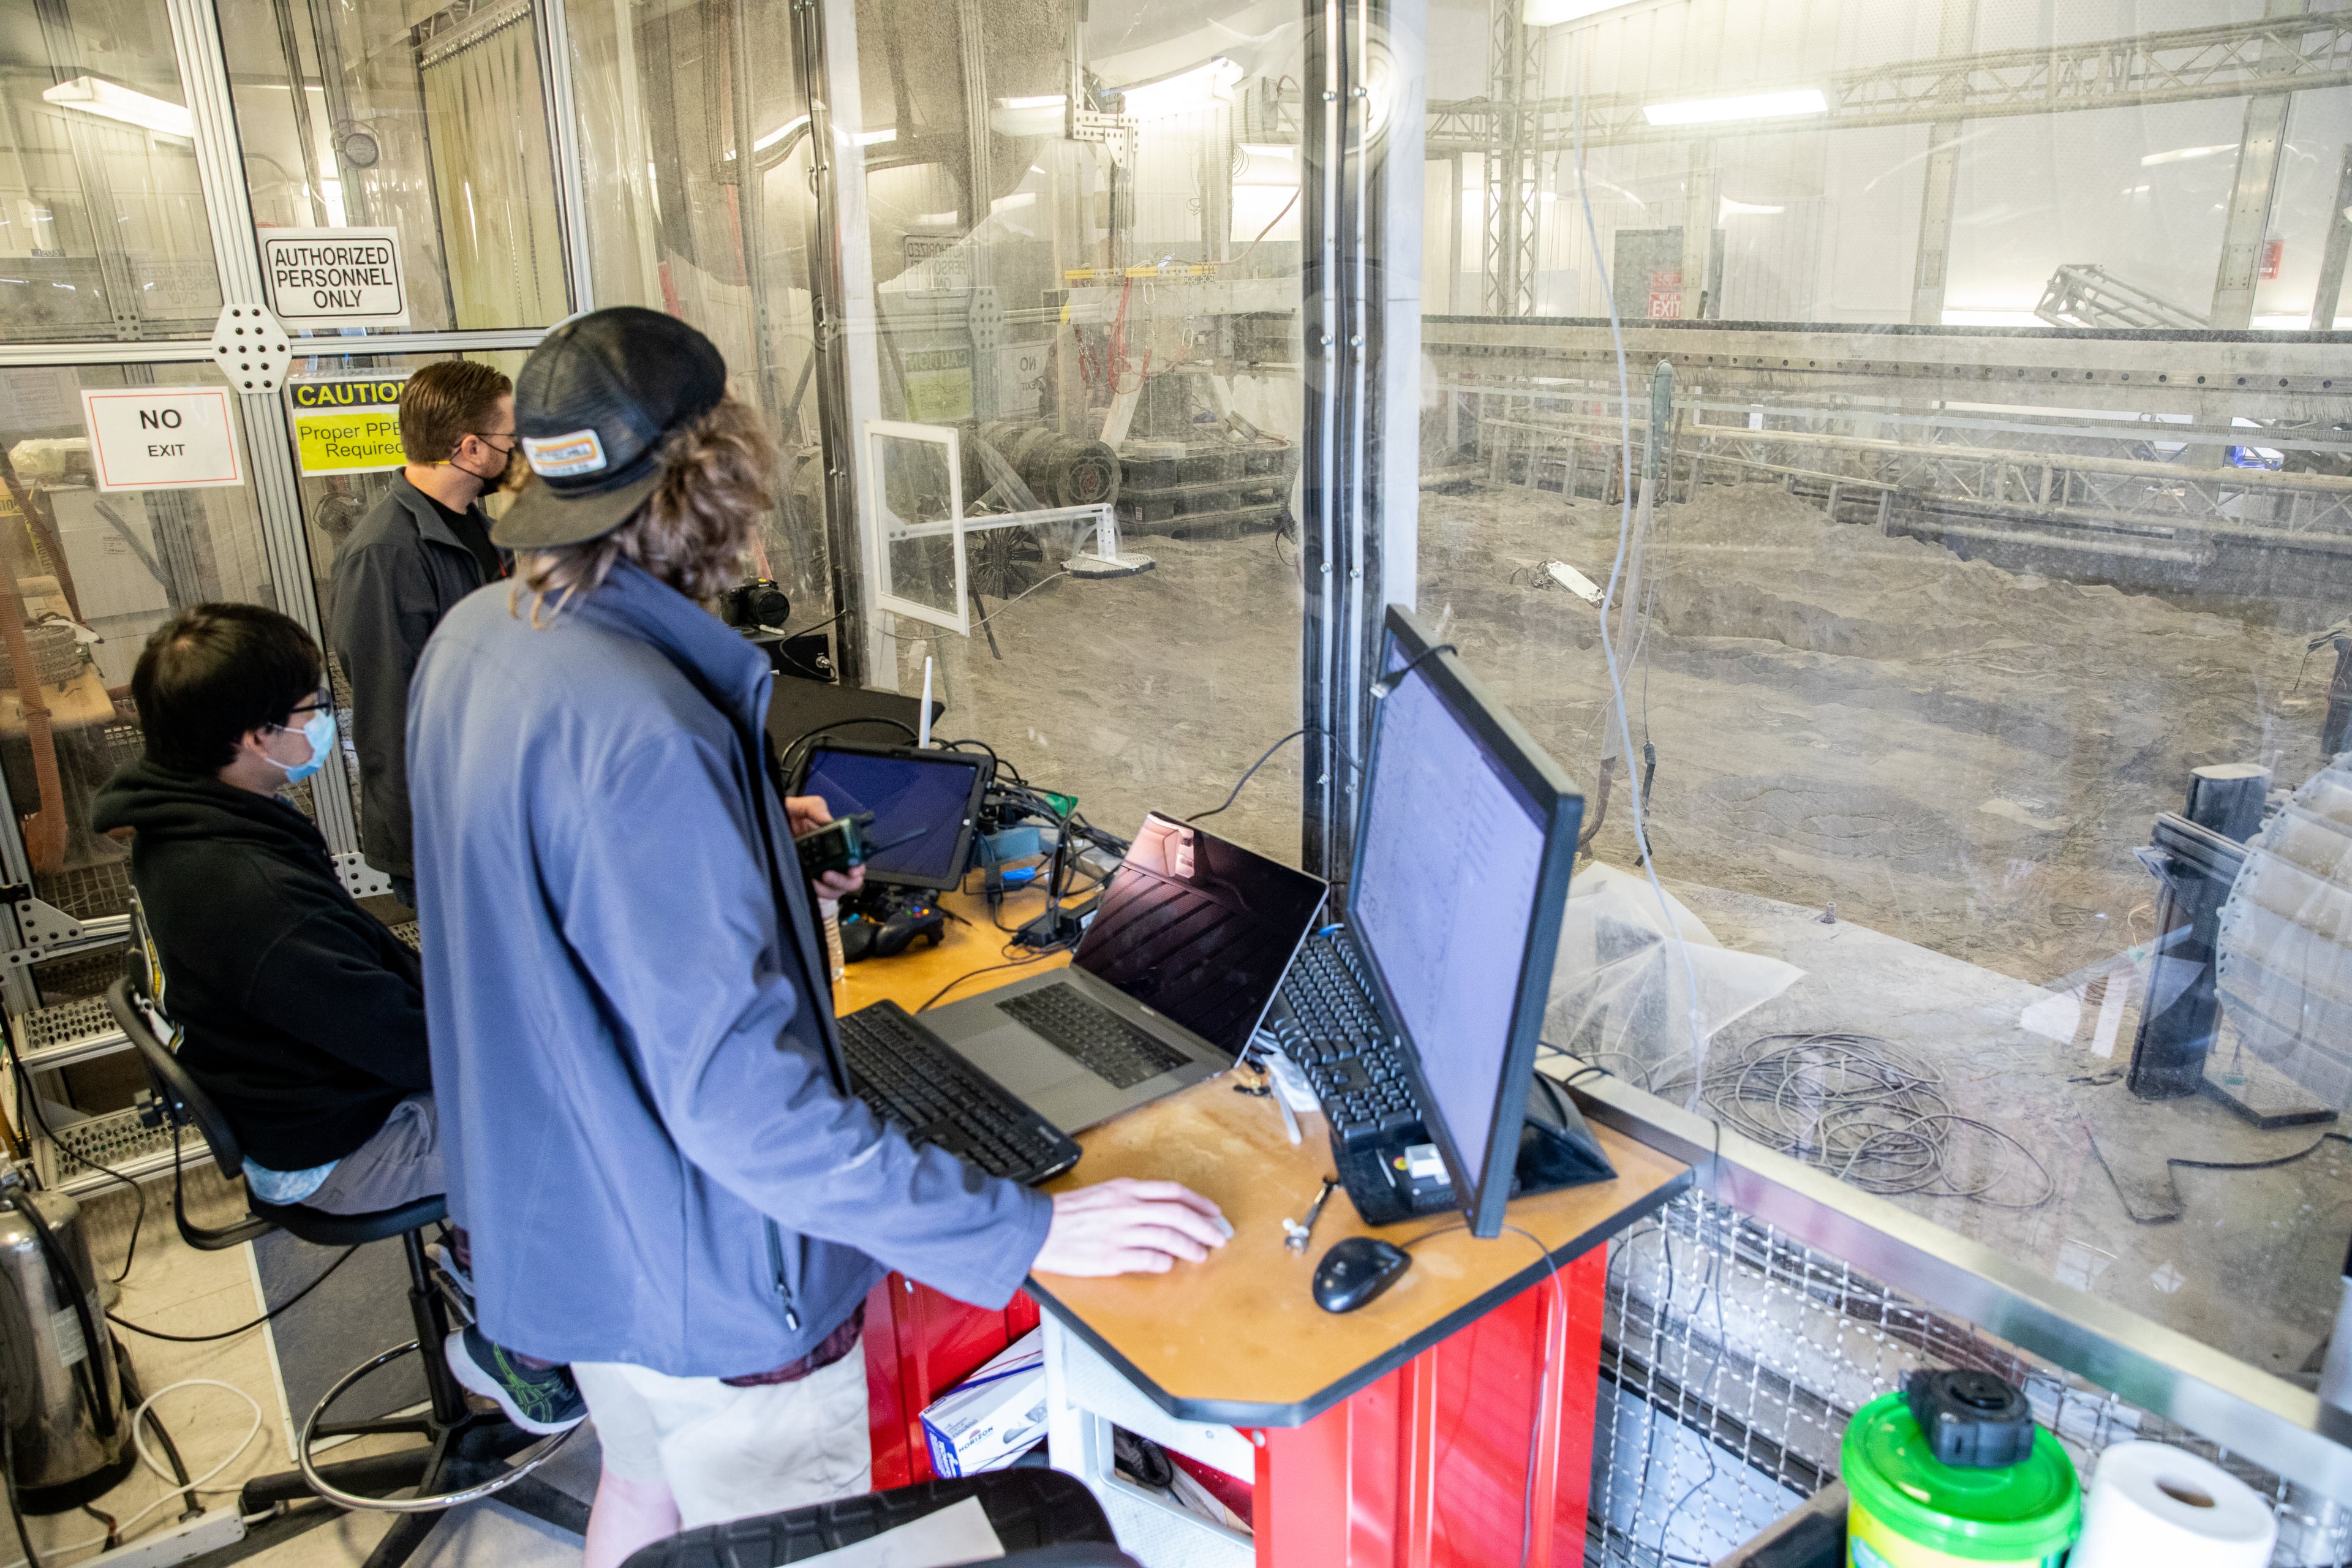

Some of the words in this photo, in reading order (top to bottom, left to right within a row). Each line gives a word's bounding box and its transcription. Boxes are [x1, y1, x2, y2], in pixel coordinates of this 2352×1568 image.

[276, 246, 389, 266] AUTHORIZED
[276, 268, 393, 288] PERSONNEL
[313, 289, 362, 308] ONLY
[1653, 300, 1681, 317] EXIT
[140, 409, 183, 429] NO
[300, 426, 360, 442] Proper
[148, 444, 185, 457] EXIT
[959, 1426, 993, 1453] HORIZON
